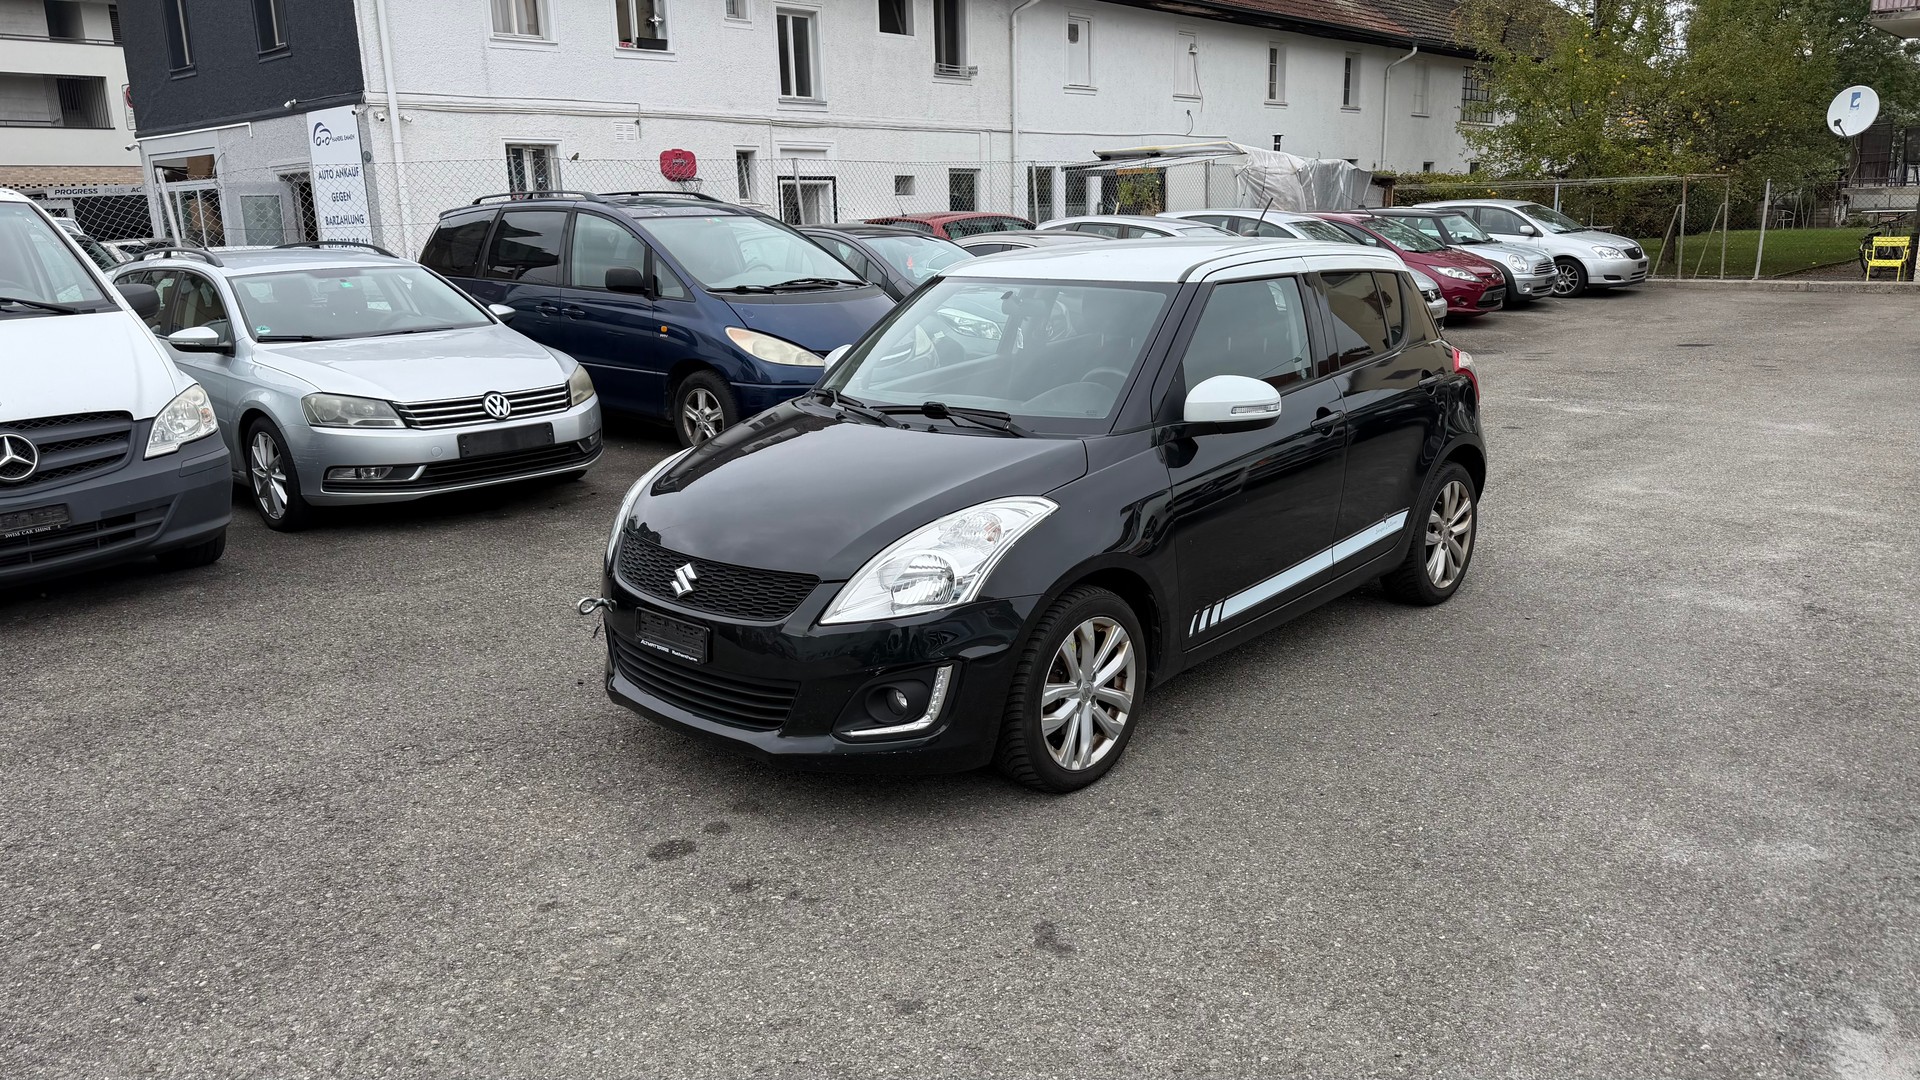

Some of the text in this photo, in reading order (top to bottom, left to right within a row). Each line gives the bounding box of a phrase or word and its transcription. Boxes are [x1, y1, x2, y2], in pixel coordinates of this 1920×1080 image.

[318, 167, 360, 180] AUTO ANKAUF
[54, 188, 98, 196] PROGRESS
[104, 187, 125, 195] PLUS
[331, 192, 352, 202] GEGEN
[325, 214, 365, 226] BARZAHLUNG
